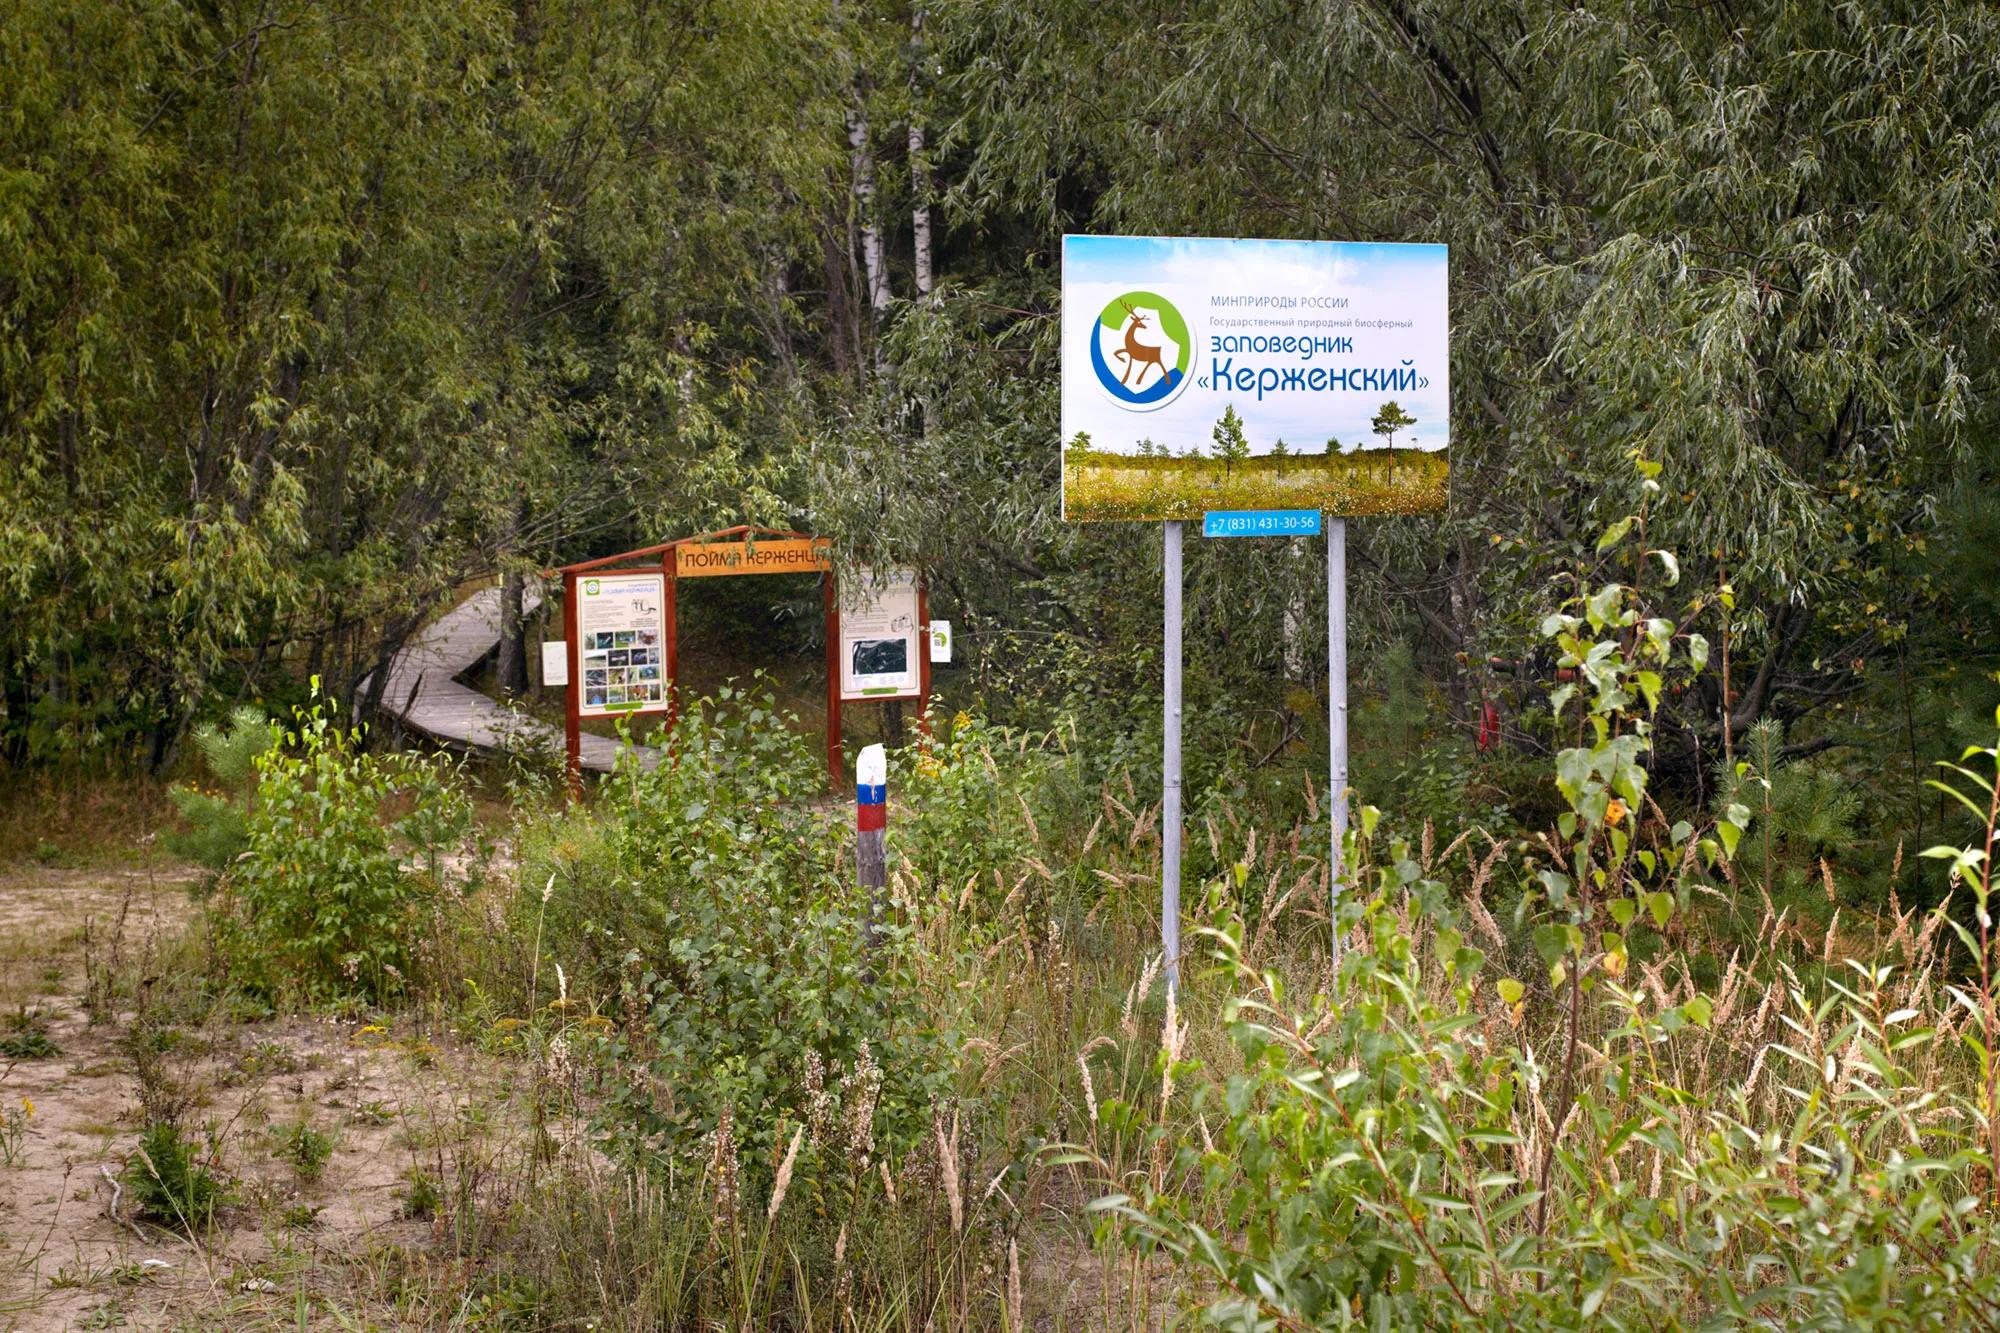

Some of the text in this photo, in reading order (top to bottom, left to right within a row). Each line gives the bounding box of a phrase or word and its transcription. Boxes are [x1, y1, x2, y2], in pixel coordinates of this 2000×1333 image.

[1210, 296, 1349, 309] МИНПРИРОДЫ РОССИИ
[1209, 316, 1413, 330] Государственный природный биосферный
[1211, 336, 1353, 359] заповедник
[1197, 358, 1430, 401] «Керженский»
[1210, 516, 1315, 531] +7 (831) 431-30-56
